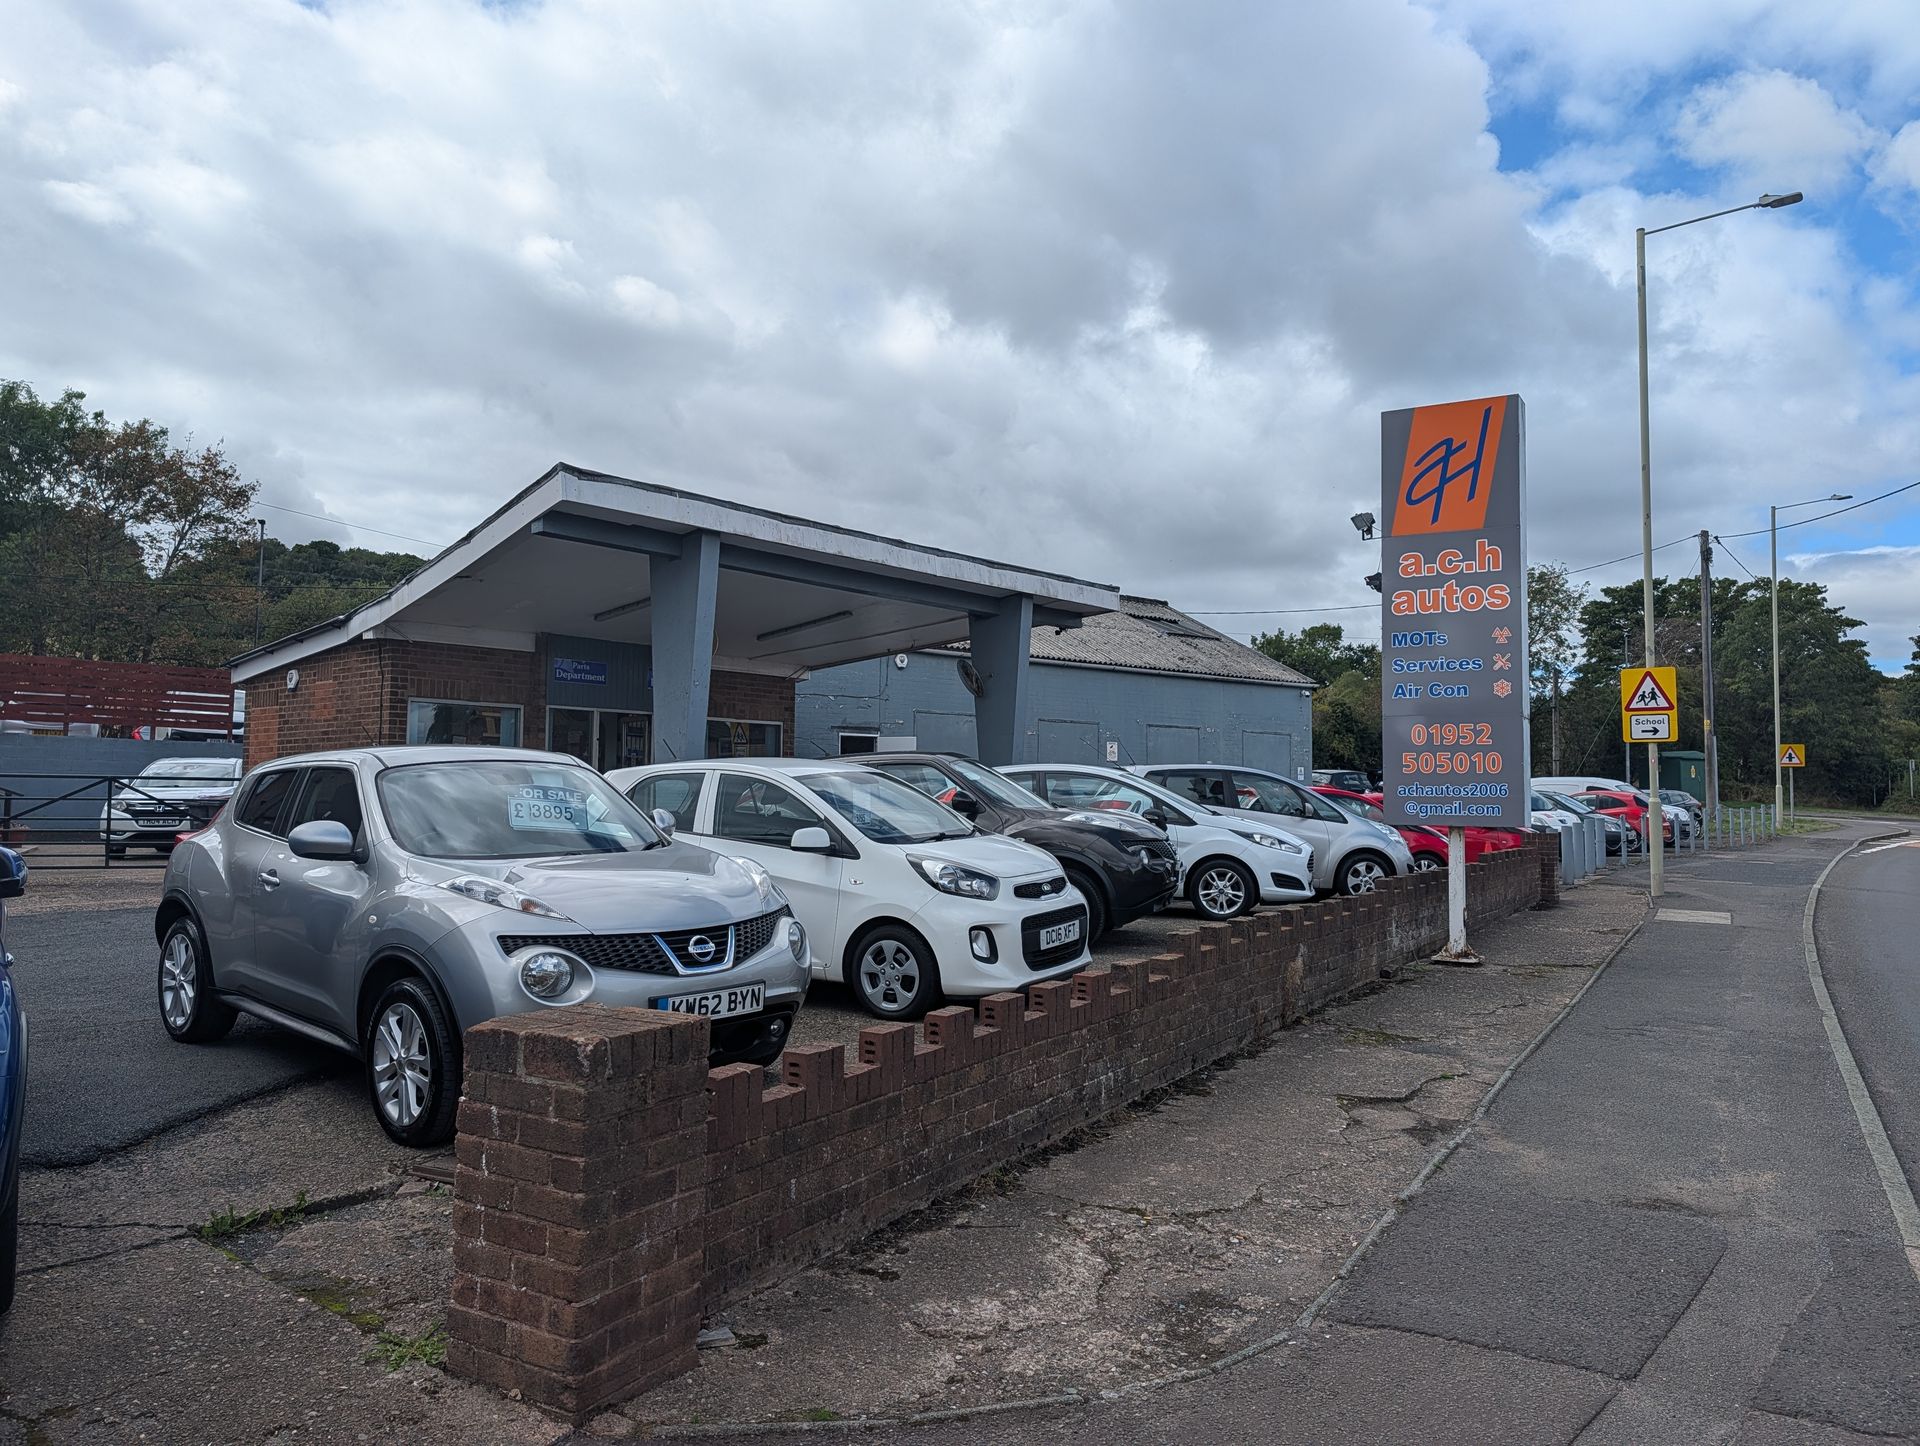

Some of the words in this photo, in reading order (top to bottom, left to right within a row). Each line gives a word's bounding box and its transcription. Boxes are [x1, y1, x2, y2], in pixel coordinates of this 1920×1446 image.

[1399, 539, 1502, 577] a.c.h
[1391, 579, 1511, 615] autos
[1391, 631, 1448, 648] MOTs
[1391, 656, 1483, 673] Services
[556, 669, 606, 682] Department
[1392, 683, 1423, 699] Air
[1428, 682, 1469, 698] Con
[1634, 718, 1666, 726] School
[1410, 723, 1493, 746] 01952
[1402, 752, 1503, 774] 505010
[547, 790, 582, 802] SALE
[1398, 782, 1509, 798] achautos2006
[1405, 801, 1502, 818] @gmail.com
[1045, 927, 1063, 945] DC16
[1063, 922, 1076, 939] XFT
[671, 994, 722, 1016] KW62
[727, 987, 762, 1013] BYN
